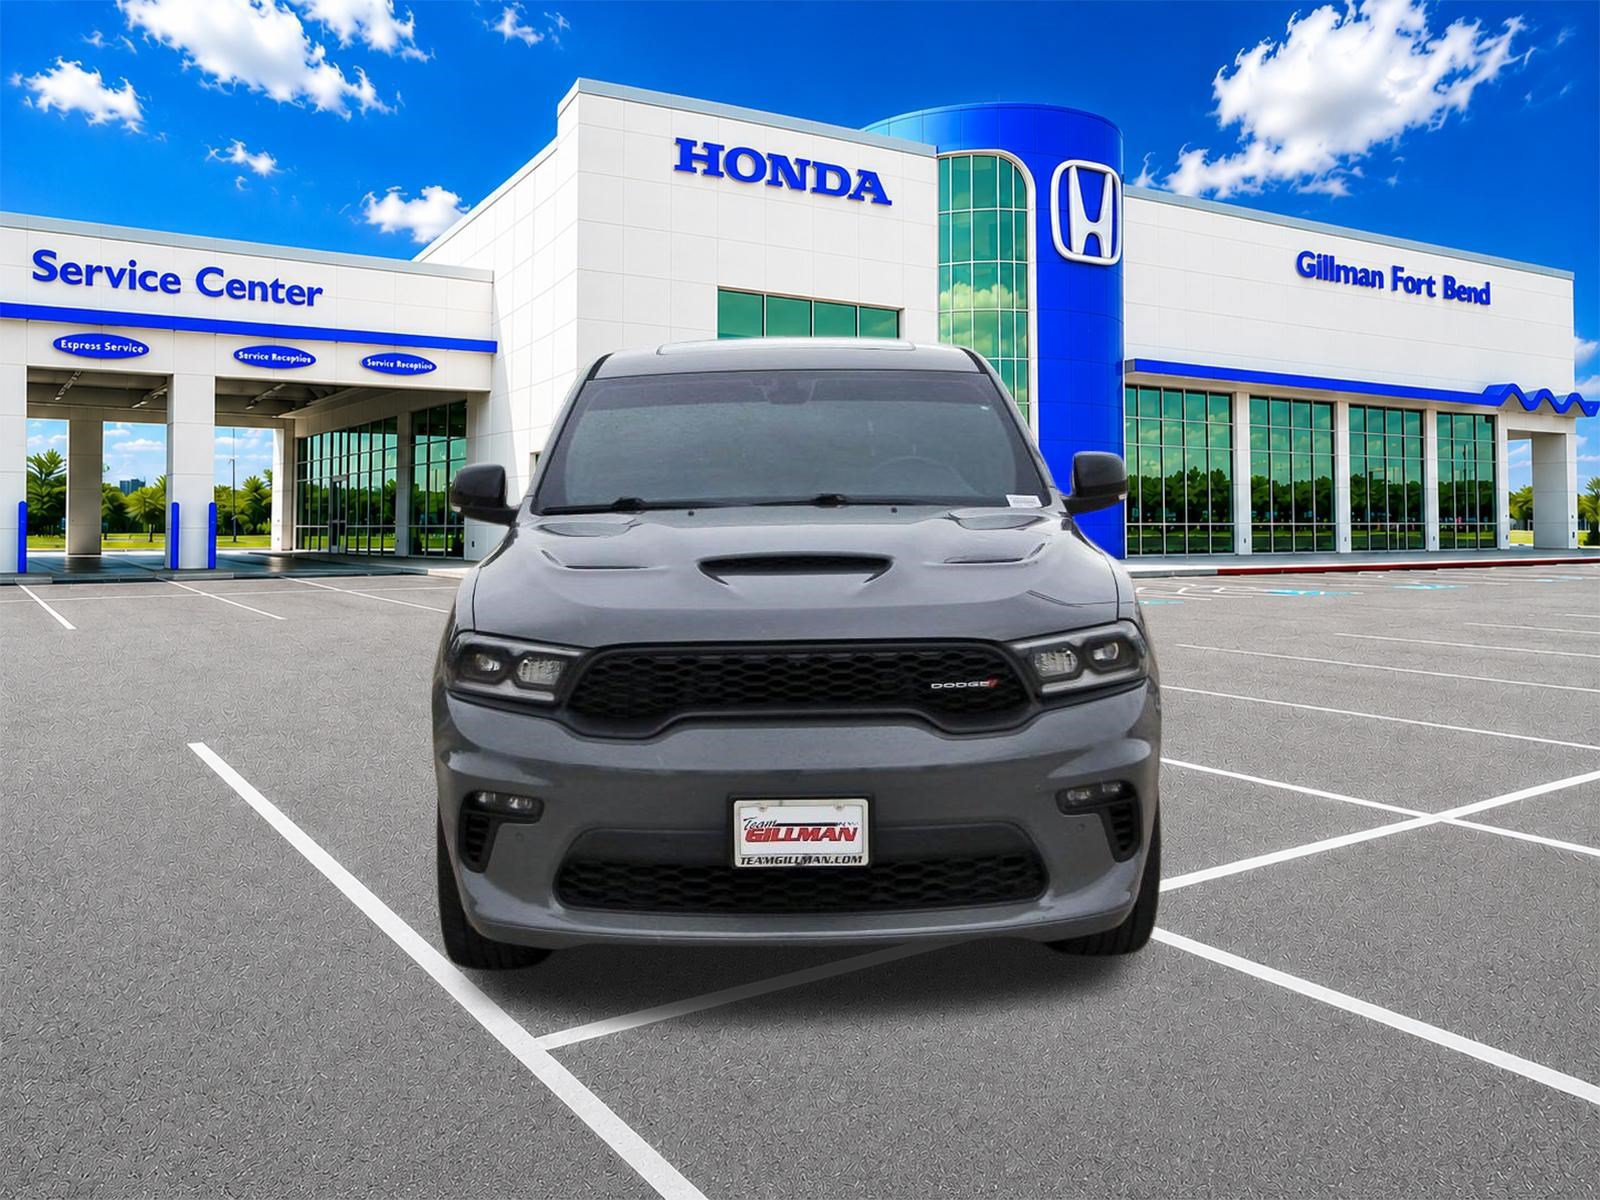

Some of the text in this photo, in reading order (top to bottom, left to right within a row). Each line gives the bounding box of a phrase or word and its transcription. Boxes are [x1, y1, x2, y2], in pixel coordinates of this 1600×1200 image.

[674, 137, 893, 206] HONDA
[32, 249, 324, 306] Service Center
[1296, 250, 1491, 305] Gillman Fort Bend
[60, 340, 144, 353] Express Service
[238, 351, 311, 364] Service Reception
[366, 358, 433, 371] Service Reception
[930, 681, 990, 689] DODGE
[743, 816, 778, 831] Team
[745, 827, 858, 843] GILLMAN
[740, 855, 863, 866] TEAMGILLMAN.COM
